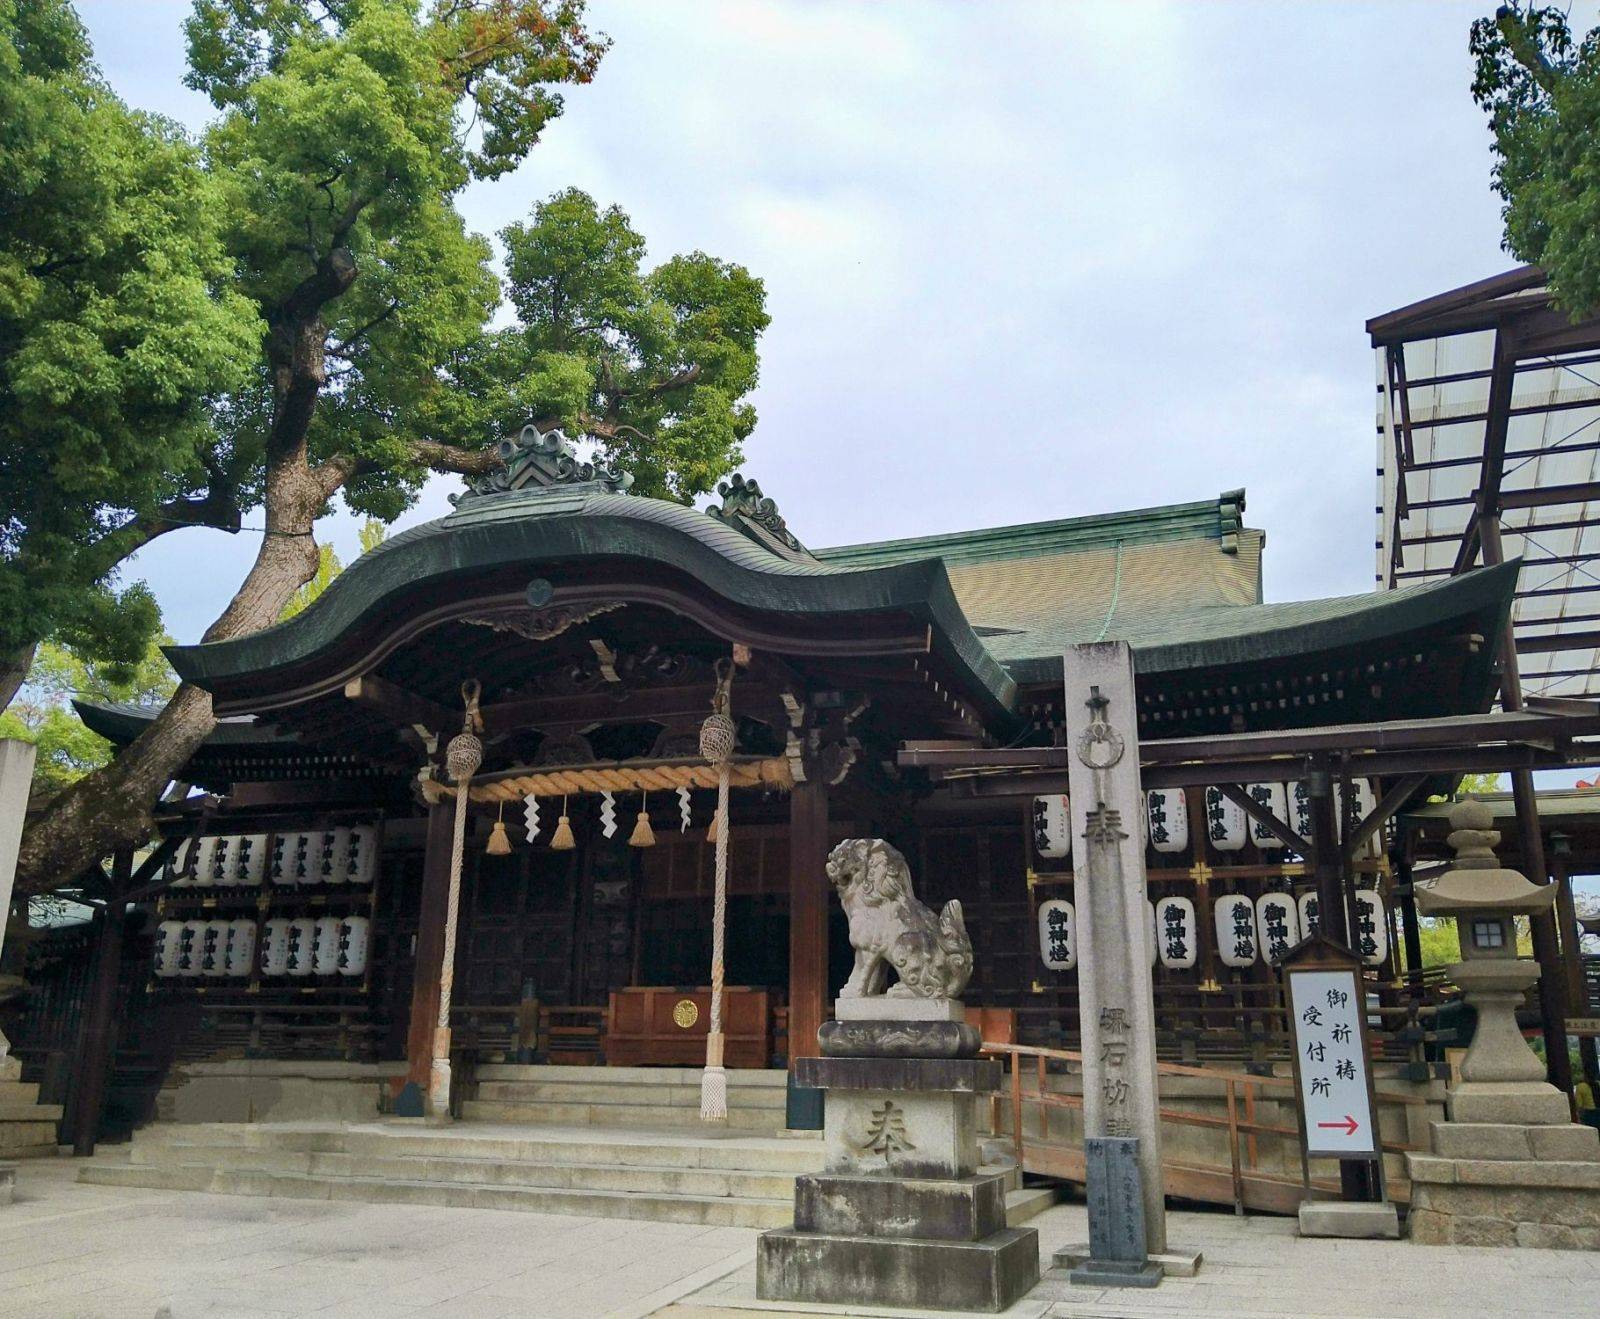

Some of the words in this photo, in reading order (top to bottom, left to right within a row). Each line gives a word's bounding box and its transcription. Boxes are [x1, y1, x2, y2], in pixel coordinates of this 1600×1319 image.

[1081, 803, 1129, 849] 奉
[1147, 790, 1169, 844] 御神燈
[1047, 908, 1069, 962] 御神燈
[1163, 903, 1188, 960] 御神燈
[1231, 901, 1255, 960] 御神燈
[1302, 1005, 1332, 1098] 受付所
[1326, 988, 1357, 1081] 御祈祷
[863, 1100, 916, 1165] 奉
